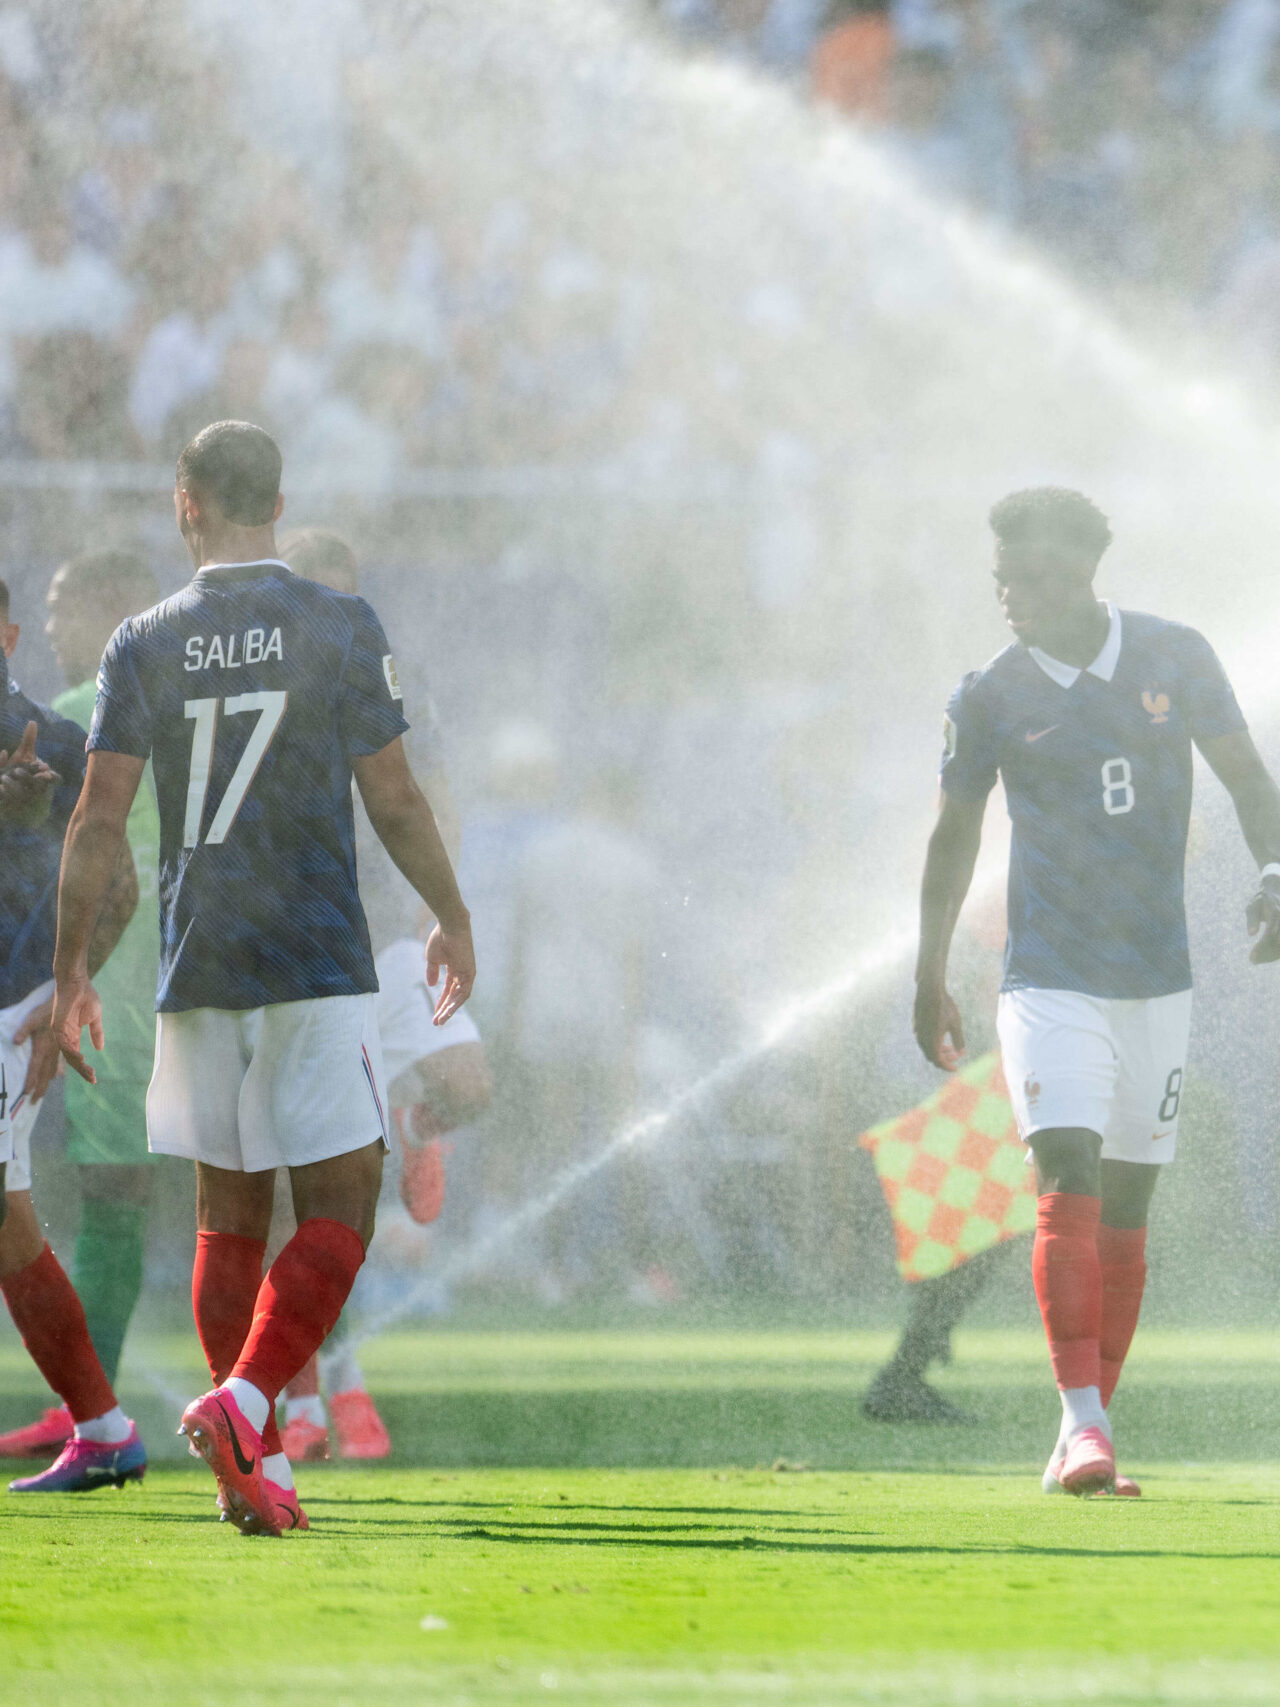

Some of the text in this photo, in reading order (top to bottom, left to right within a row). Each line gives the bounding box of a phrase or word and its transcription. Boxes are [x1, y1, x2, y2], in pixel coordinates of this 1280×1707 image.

[184, 691, 288, 848] 17
[1101, 757, 1135, 816] 8
[1158, 1067, 1182, 1122] 8
